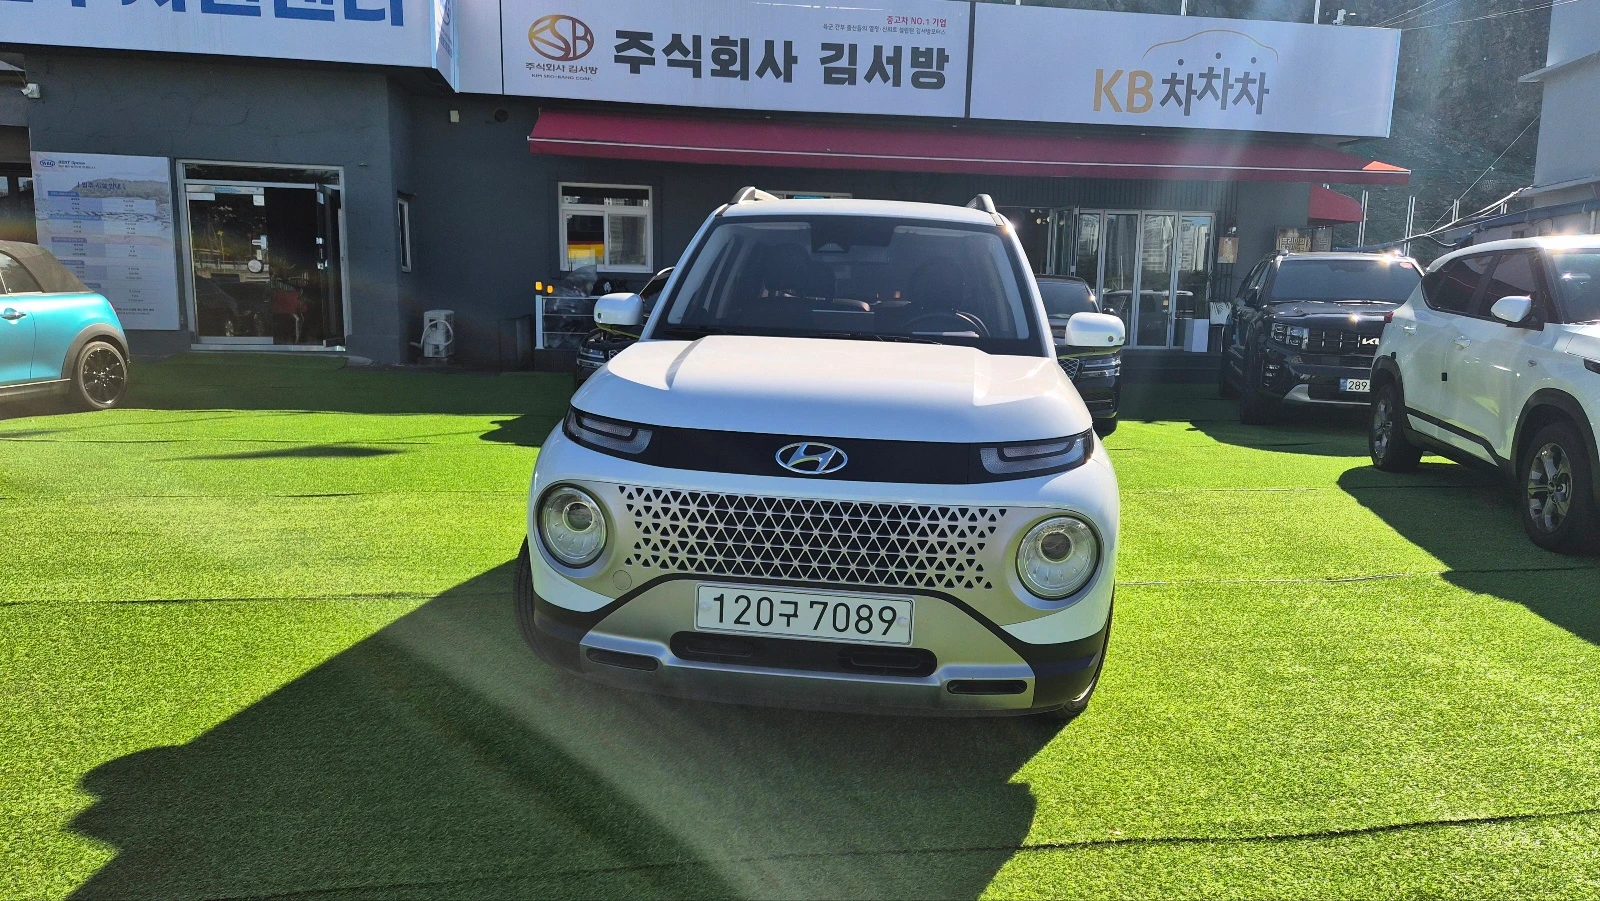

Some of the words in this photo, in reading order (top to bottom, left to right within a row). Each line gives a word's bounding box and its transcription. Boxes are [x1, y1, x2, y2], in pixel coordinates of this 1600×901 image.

[886, 15, 908, 25] 중고차
[910, 17, 930, 26] NO.1
[932, 18, 947, 28] 기업
[613, 29, 798, 84] 주식회사
[818, 42, 950, 90] 김서방
[525, 62, 565, 73] 주식회사
[568, 64, 599, 75] 김서방
[1348, 380, 1370, 391] 289
[713, 593, 799, 628] 120구
[809, 600, 898, 636] 7089
